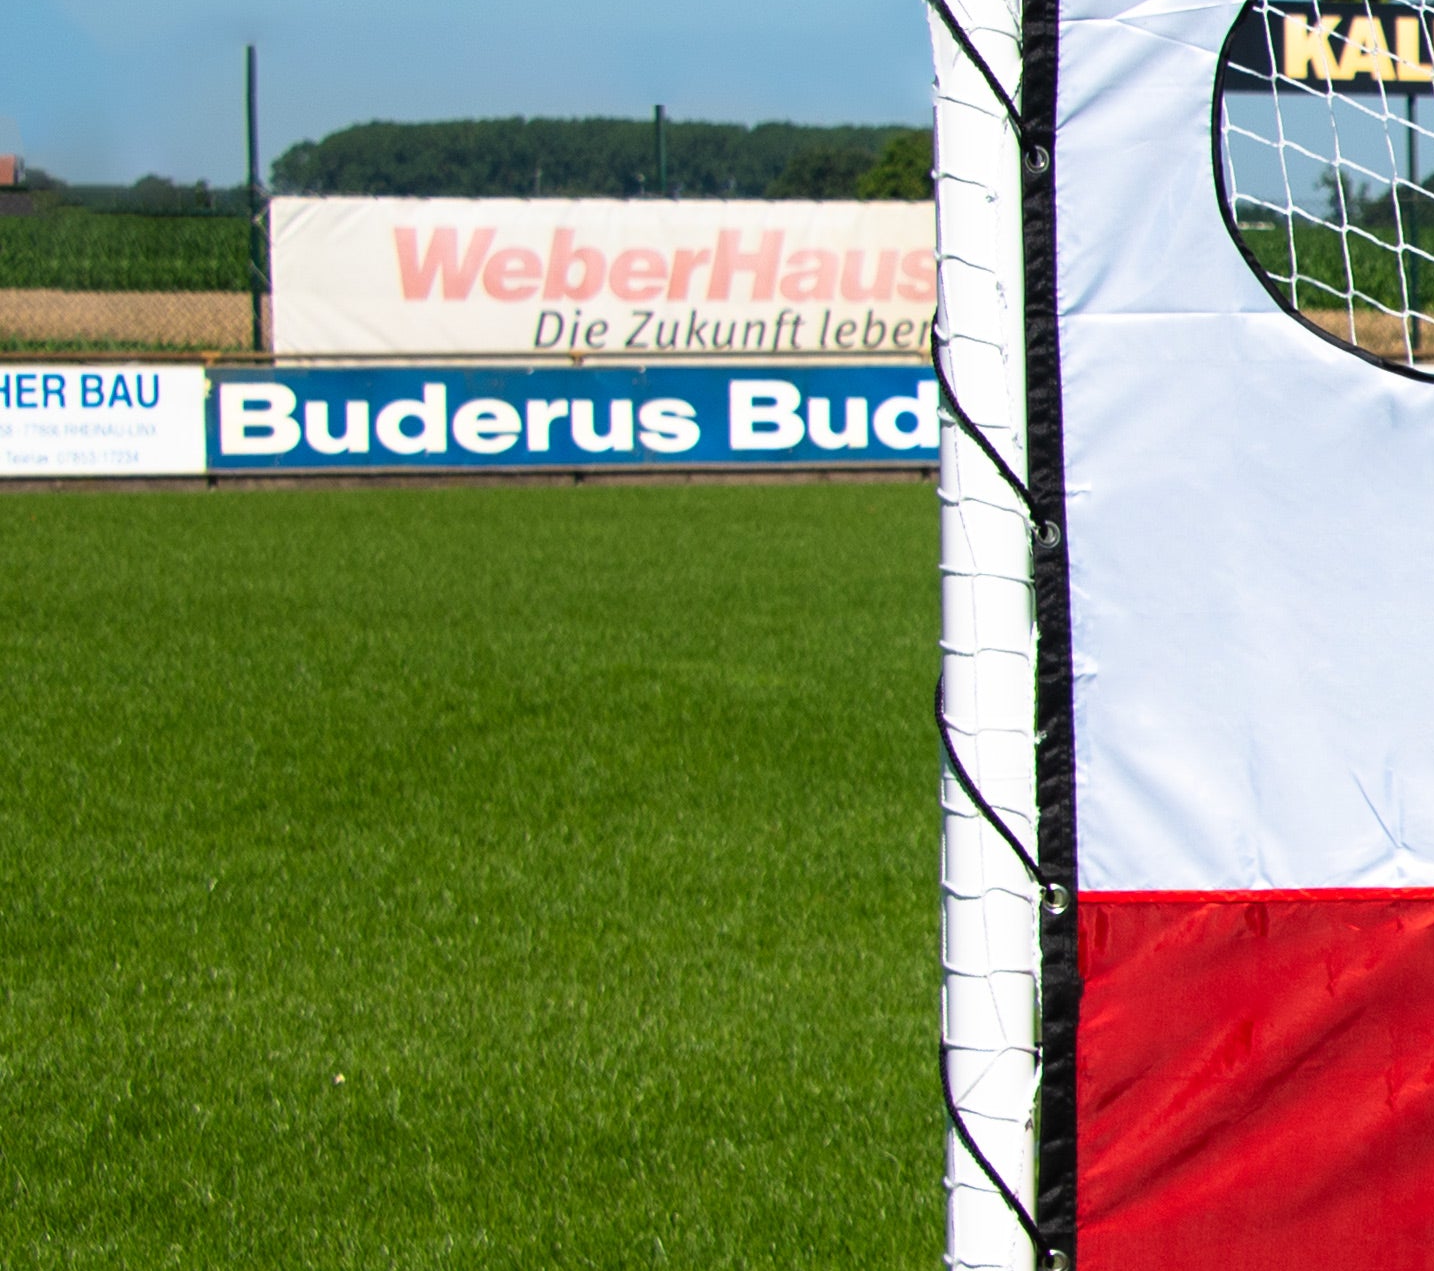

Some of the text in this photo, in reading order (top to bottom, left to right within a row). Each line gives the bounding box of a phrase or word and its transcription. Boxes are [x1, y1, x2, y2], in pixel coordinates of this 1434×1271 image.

[393, 226, 937, 303] WeberHaus
[534, 309, 609, 348] Die
[626, 308, 806, 352] Zukunft
[80, 374, 159, 409] BAU
[219, 381, 701, 455] Buderus
